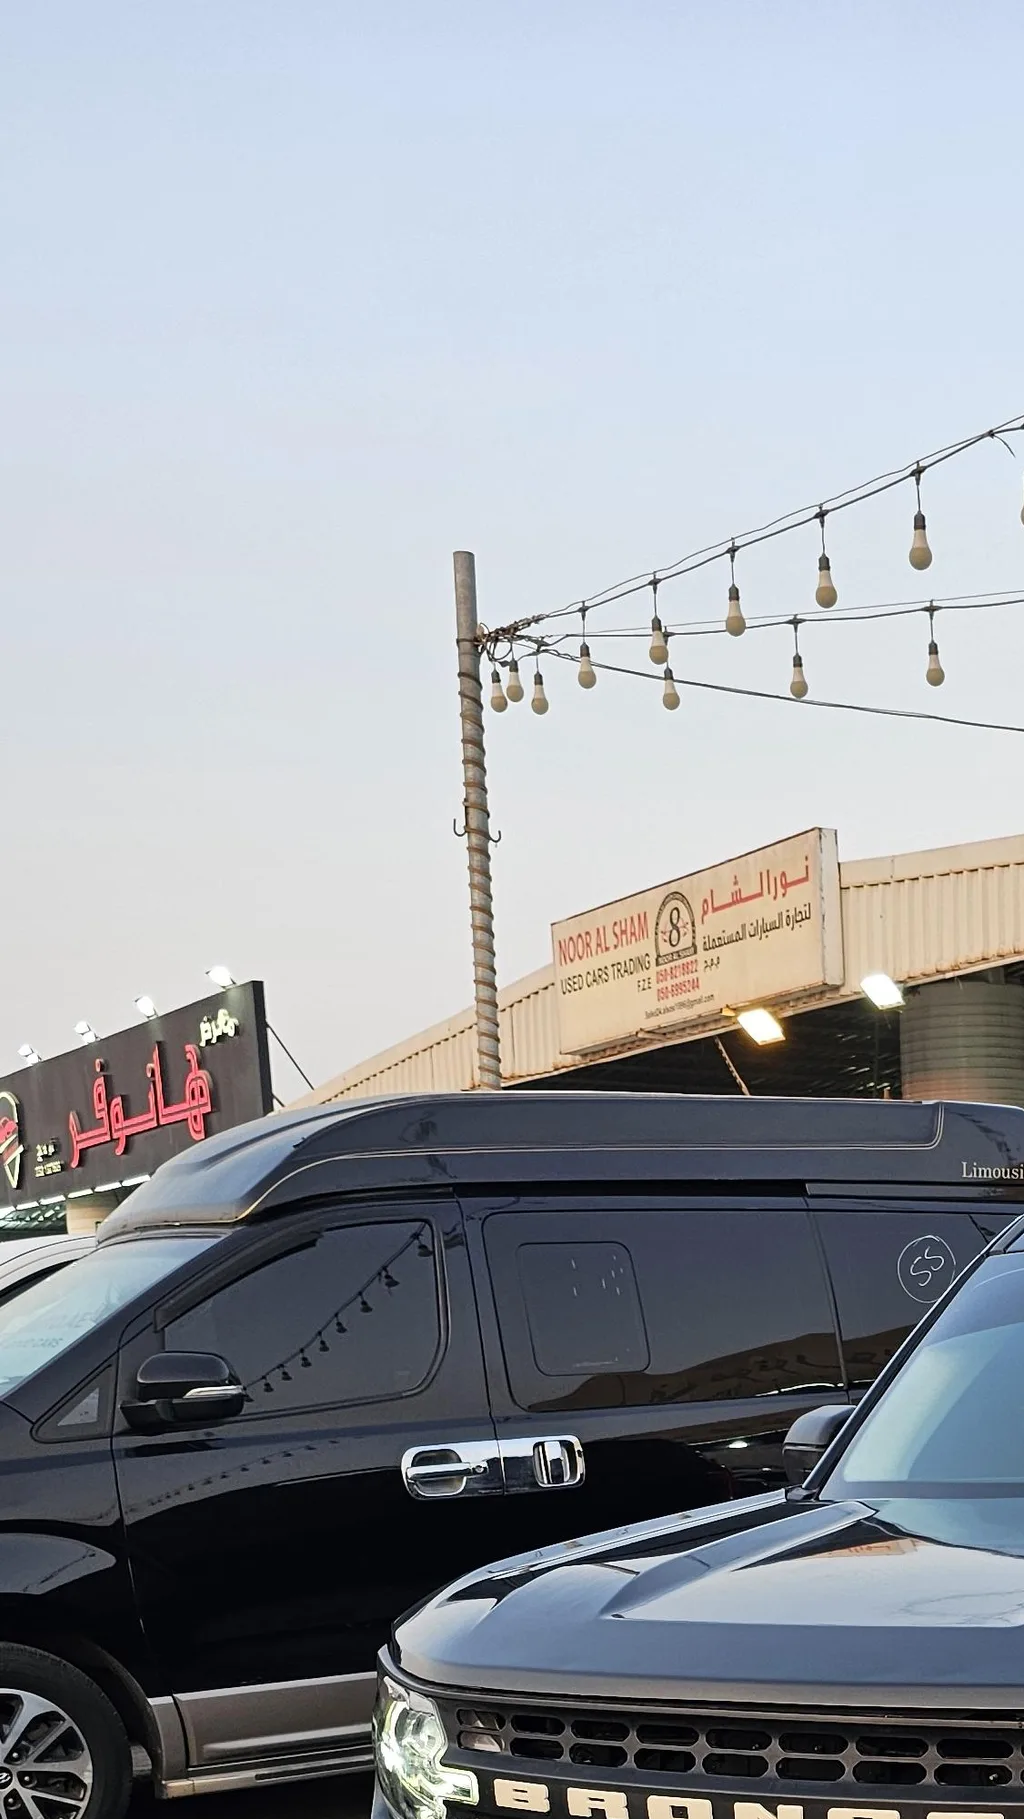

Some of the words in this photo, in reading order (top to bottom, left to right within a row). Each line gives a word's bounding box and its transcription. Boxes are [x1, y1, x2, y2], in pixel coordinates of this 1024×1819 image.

[748, 911, 784, 940] السيارات
[785, 902, 811, 931] لتجارة
[558, 930, 593, 967] NOOR
[595, 925, 610, 956] AL
[612, 911, 650, 950] SHAM
[702, 922, 748, 952] المستعملة
[560, 974, 584, 995] USED
[585, 966, 609, 988] CARS
[611, 953, 651, 980] TRADING
[69, 1042, 212, 1169] هانوفر
